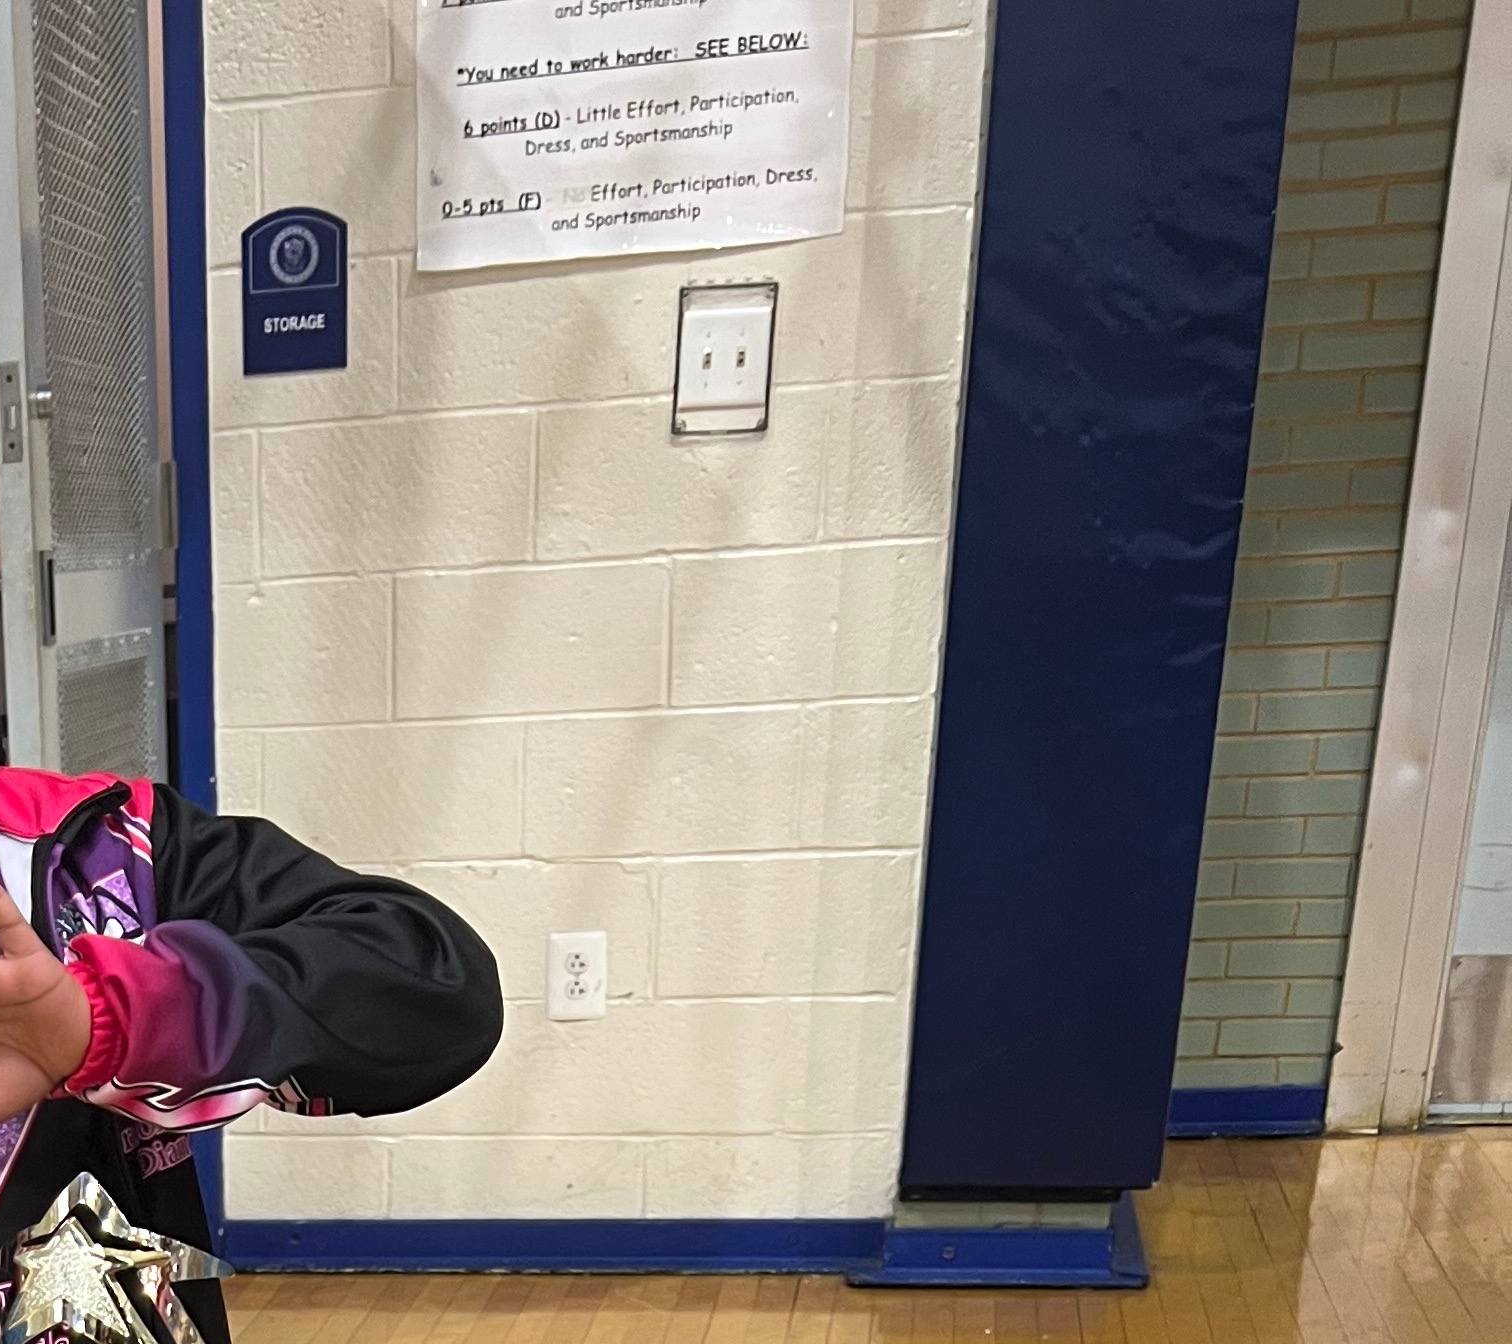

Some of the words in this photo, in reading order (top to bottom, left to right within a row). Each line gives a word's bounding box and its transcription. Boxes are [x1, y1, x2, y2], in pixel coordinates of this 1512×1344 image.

[555, 1, 583, 19] and
[501, 59, 538, 80] need
[547, 59, 562, 75] to
[570, 52, 608, 72] work
[616, 47, 679, 68] harder:
[695, 38, 729, 59] SEE
[738, 31, 808, 55] BELOW:
[463, 119, 474, 138] 6
[481, 114, 527, 139] points
[534, 109, 561, 131] (D)
[577, 103, 621, 126] Little
[627, 98, 686, 121] Effort,
[690, 87, 799, 115] Participation,
[526, 138, 576, 158] Dress,
[581, 131, 608, 150] and
[614, 120, 734, 149] Sportsmanship
[441, 199, 473, 219] 0-5
[480, 196, 504, 218] pts
[518, 191, 542, 212] (F)
[591, 181, 648, 203] Effort,
[652, 172, 759, 198] Participation,
[766, 166, 818, 187] Dress,
[552, 212, 578, 232] and
[585, 203, 701, 231] Sportsmanship
[264, 313, 326, 334] STORAGE
